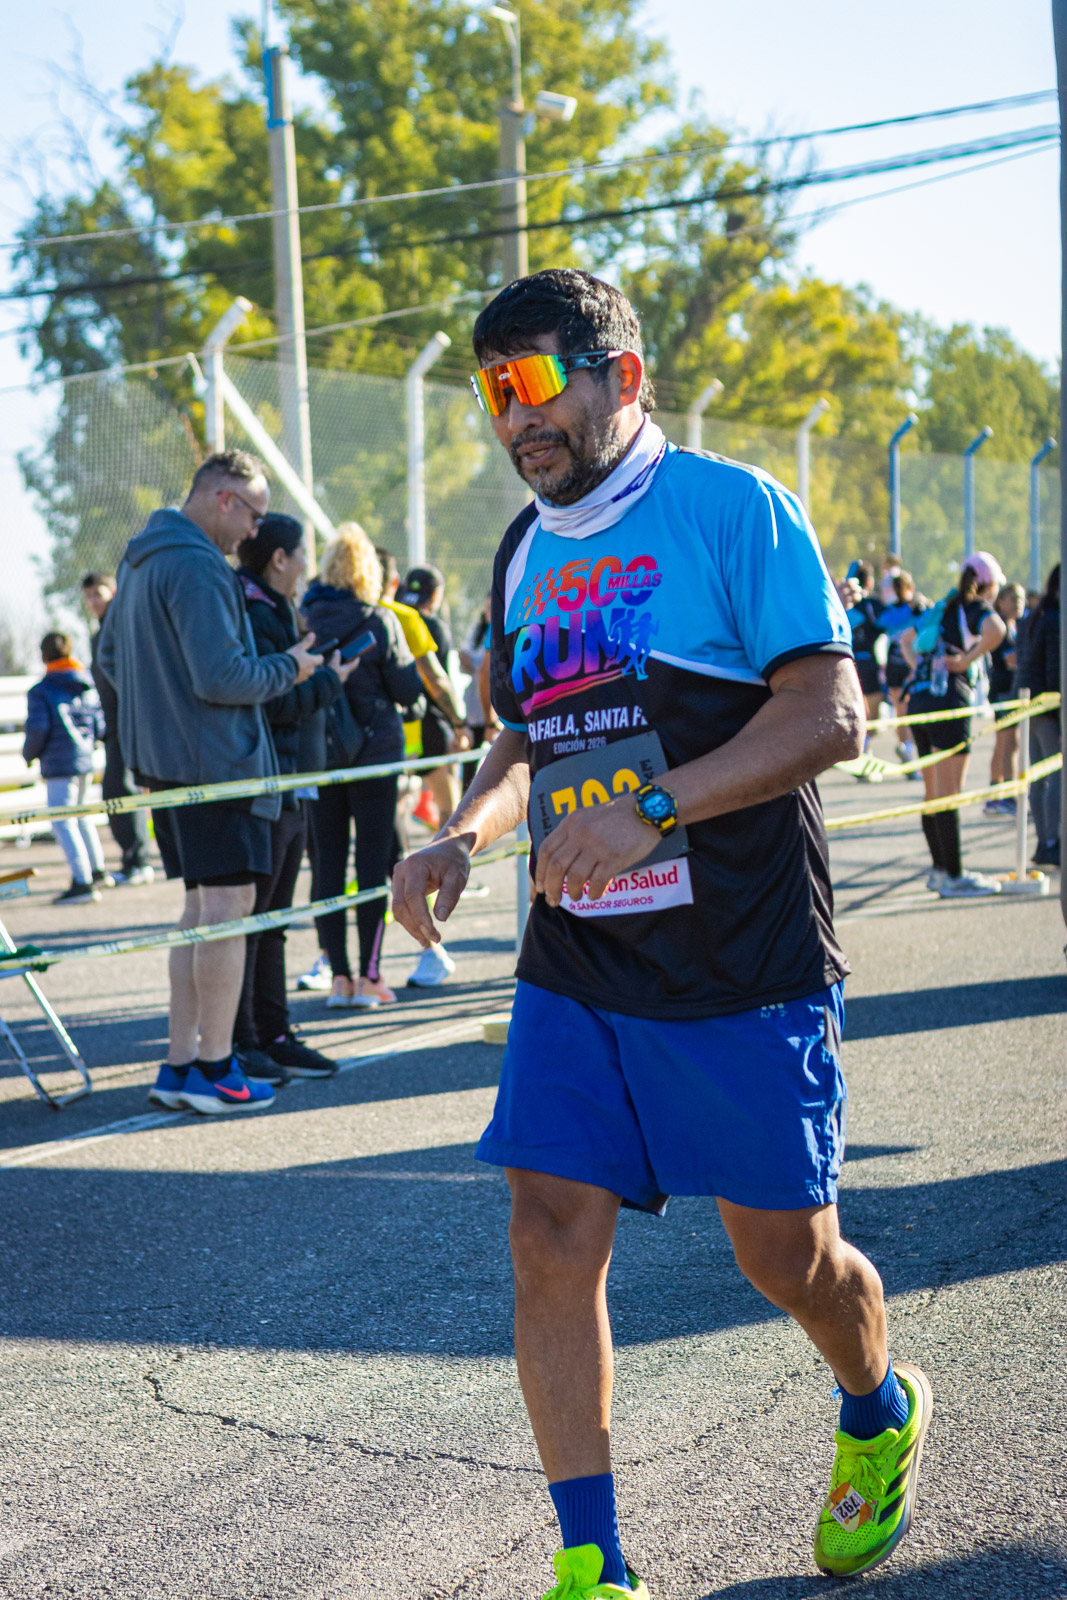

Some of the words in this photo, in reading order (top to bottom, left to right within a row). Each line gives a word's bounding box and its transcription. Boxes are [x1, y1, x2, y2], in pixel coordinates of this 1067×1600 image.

[607, 572, 662, 590] MILLAS
[511, 608, 637, 694] RUN
[584, 706, 629, 733] SANTA
[553, 736, 586, 755] EDICIÓN
[630, 865, 679, 890] Salud
[577, 899, 612, 911] SANCOR
[613, 896, 654, 908] SEGUROS
[836, 1496, 861, 1519] 792
